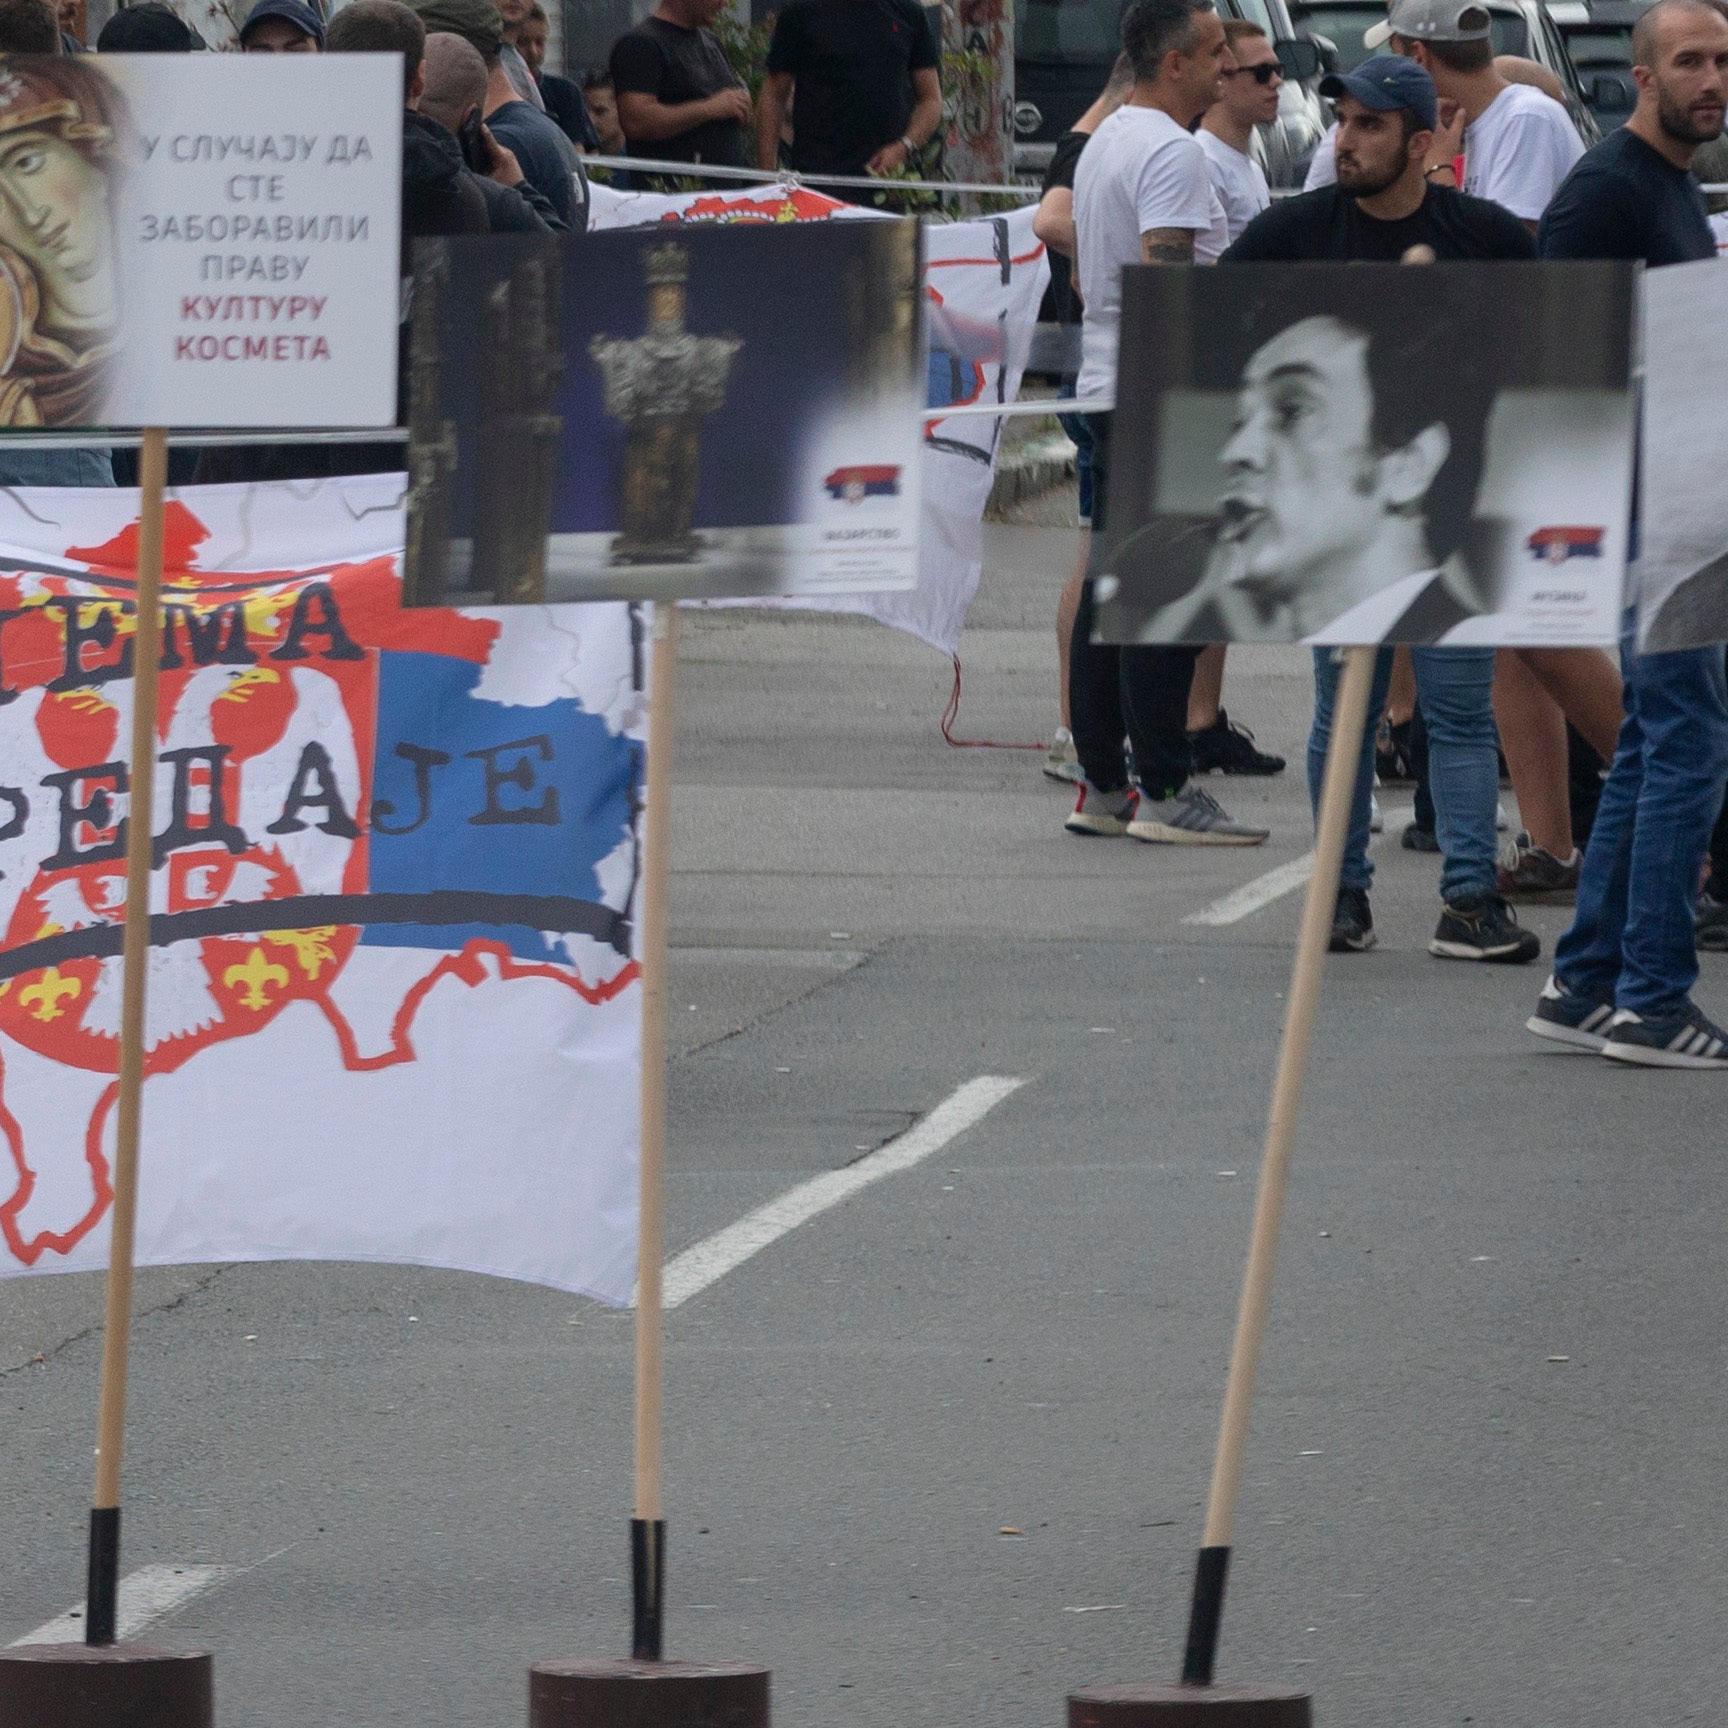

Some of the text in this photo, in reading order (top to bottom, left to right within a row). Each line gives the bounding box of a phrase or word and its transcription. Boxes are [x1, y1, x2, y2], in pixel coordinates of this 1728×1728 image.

[141, 135, 373, 165] У СЛУЧАЈУ ДА
[227, 174, 285, 202] СТЕ
[140, 214, 369, 242] ЗАБОРАВИЛИ
[200, 254, 310, 282] ПРАВУ
[180, 295, 328, 321] КУЛТУРУ
[175, 335, 332, 361] КОСМЕТА
